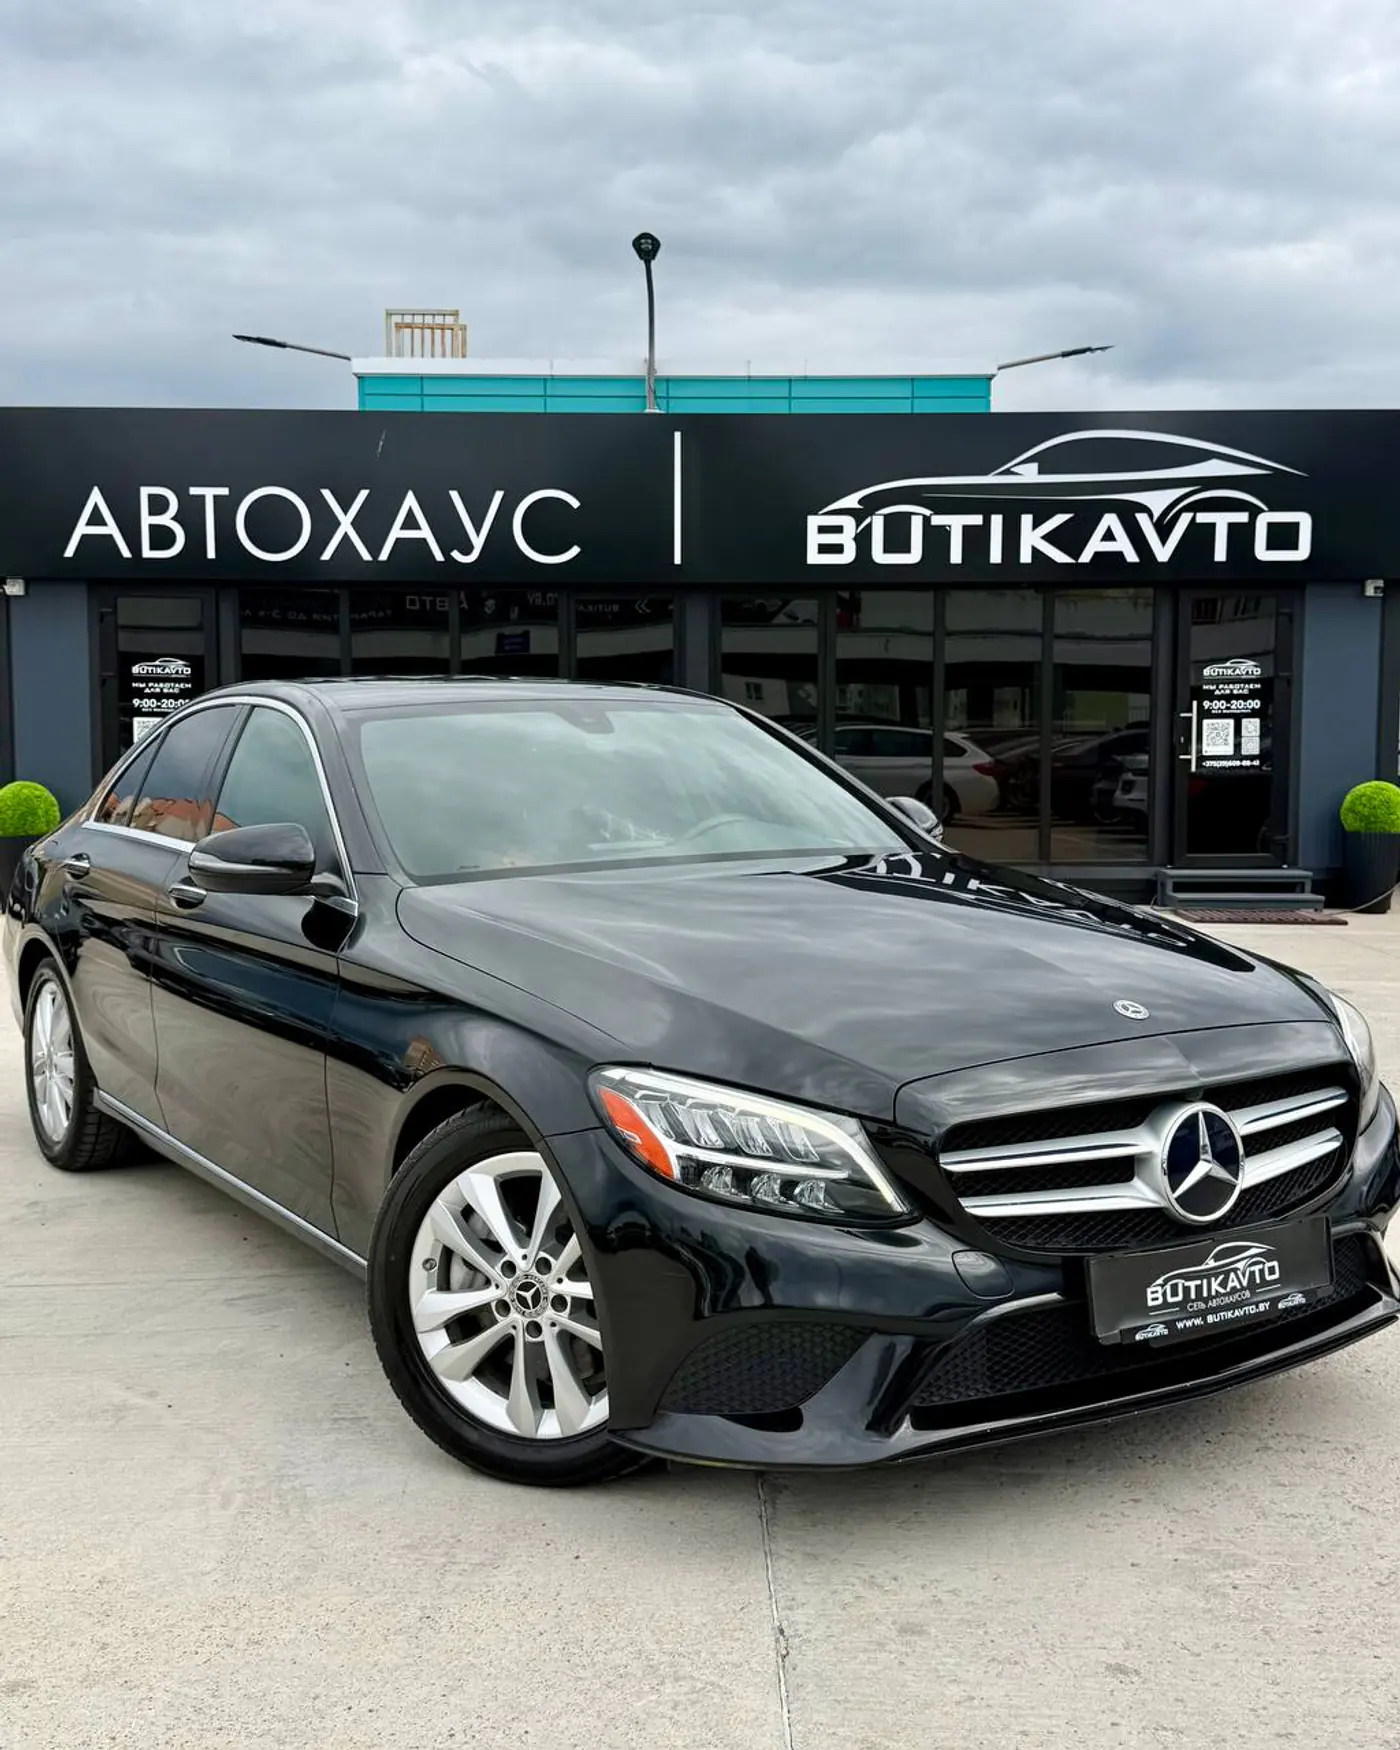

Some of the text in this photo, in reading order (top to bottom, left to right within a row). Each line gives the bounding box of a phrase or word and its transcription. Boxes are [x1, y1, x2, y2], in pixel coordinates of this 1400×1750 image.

[63, 486, 582, 564] АВТОХАУС
[806, 511, 1312, 565] BUTIKAVTO
[1203, 668, 1261, 676] BUTIKAVTO
[1202, 700, 1261, 710] 9:00-20:00
[1146, 1260, 1280, 1307] BUTIKAVTO
[1186, 1290, 1251, 1312] СЕТЬ АВТОХАУСОВ
[1176, 1302, 1271, 1330] WWW. BUTIKAVTO.BY
